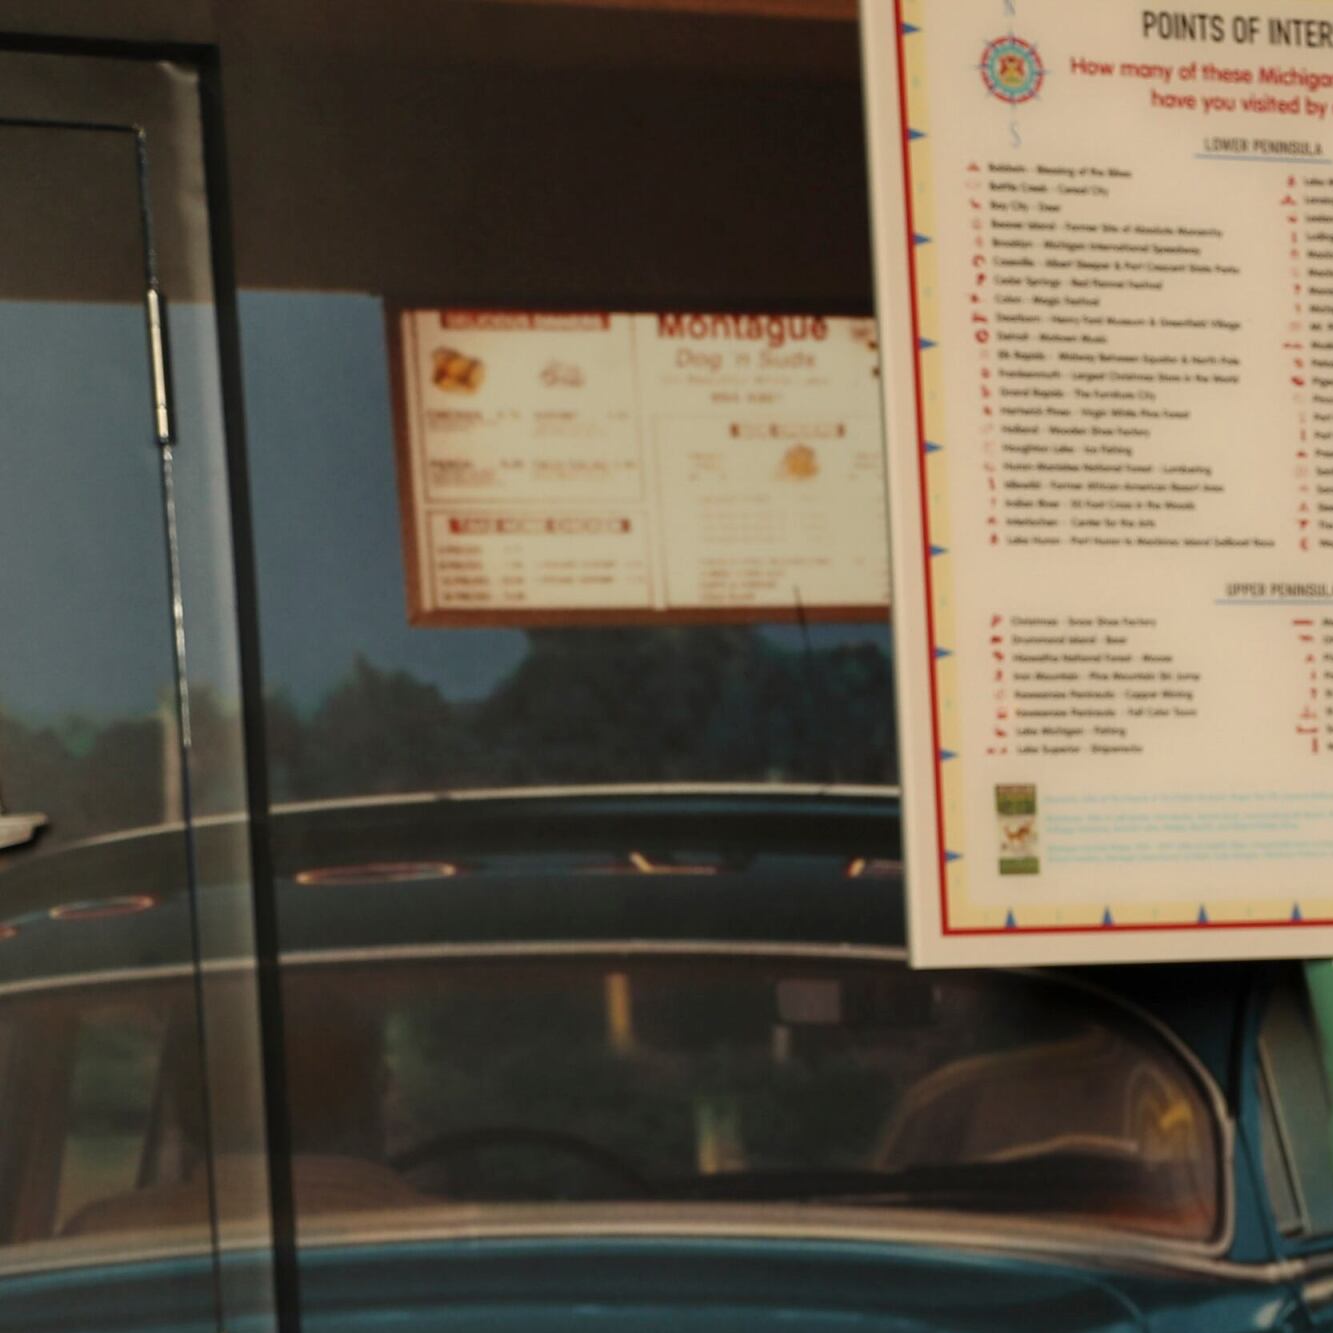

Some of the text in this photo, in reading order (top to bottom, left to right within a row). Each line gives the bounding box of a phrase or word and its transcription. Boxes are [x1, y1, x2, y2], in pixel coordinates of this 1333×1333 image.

[1142, 11, 1224, 44] POINTS
[1232, 15, 1259, 46] OF
[1070, 57, 1113, 77] How
[1121, 63, 1173, 84] many
[1180, 62, 1199, 82] of
[1202, 62, 1252, 84] these
[1151, 90, 1196, 110] have
[1202, 96, 1237, 117] you
[1242, 93, 1300, 115] visited
[1306, 95, 1328, 119] by
[1204, 137, 1323, 158] LOWER PENINSULA
[658, 313, 830, 347] Montague
[1226, 582, 1267, 597] UPPER
